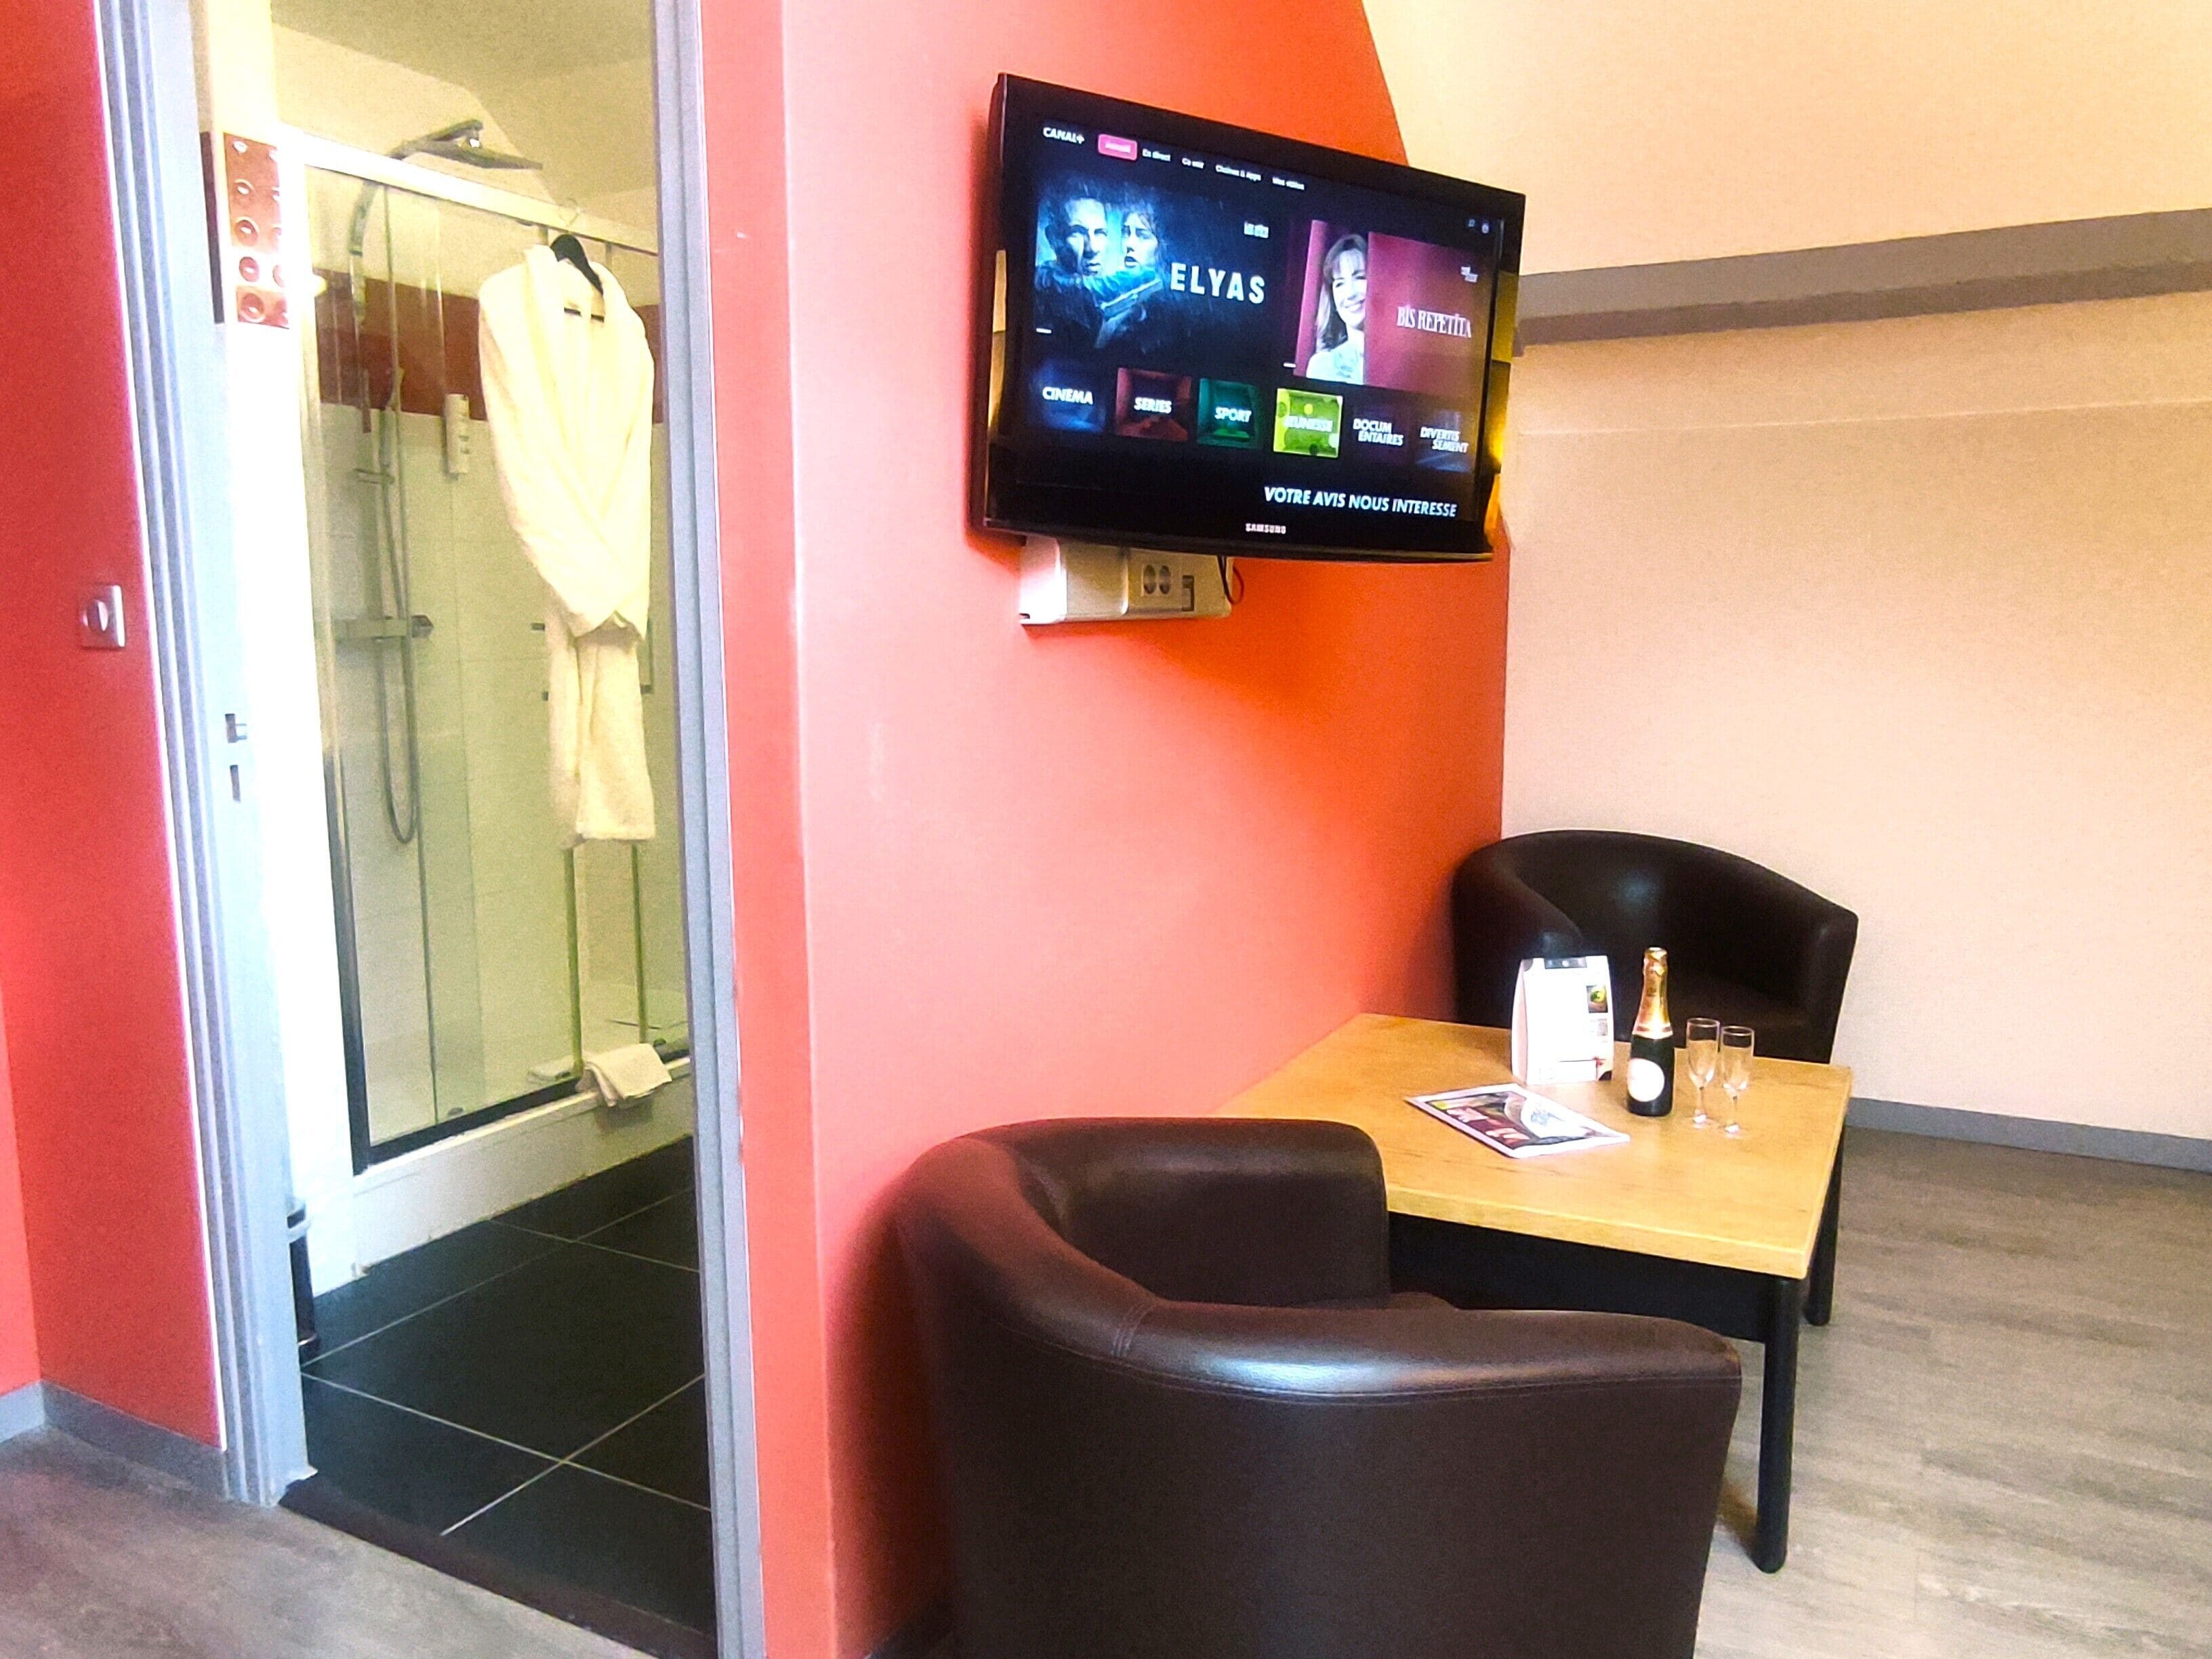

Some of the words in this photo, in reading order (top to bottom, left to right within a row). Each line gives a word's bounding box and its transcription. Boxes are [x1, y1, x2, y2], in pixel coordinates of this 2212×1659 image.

[1170, 262, 1265, 304] ELYAS
[1397, 305, 1416, 329] BIS
[1042, 386, 1094, 405] CINEMA
[1134, 396, 1172, 414] SERIES
[1214, 407, 1252, 423] SPORT
[1353, 417, 1393, 434] DOCUM
[1263, 486, 1312, 506] VOTRE
[1312, 491, 1347, 508] AVIS
[1348, 494, 1390, 512] NOUS
[1391, 498, 1458, 518] INTERESSE
[1245, 523, 1287, 535] SAMSUNG
